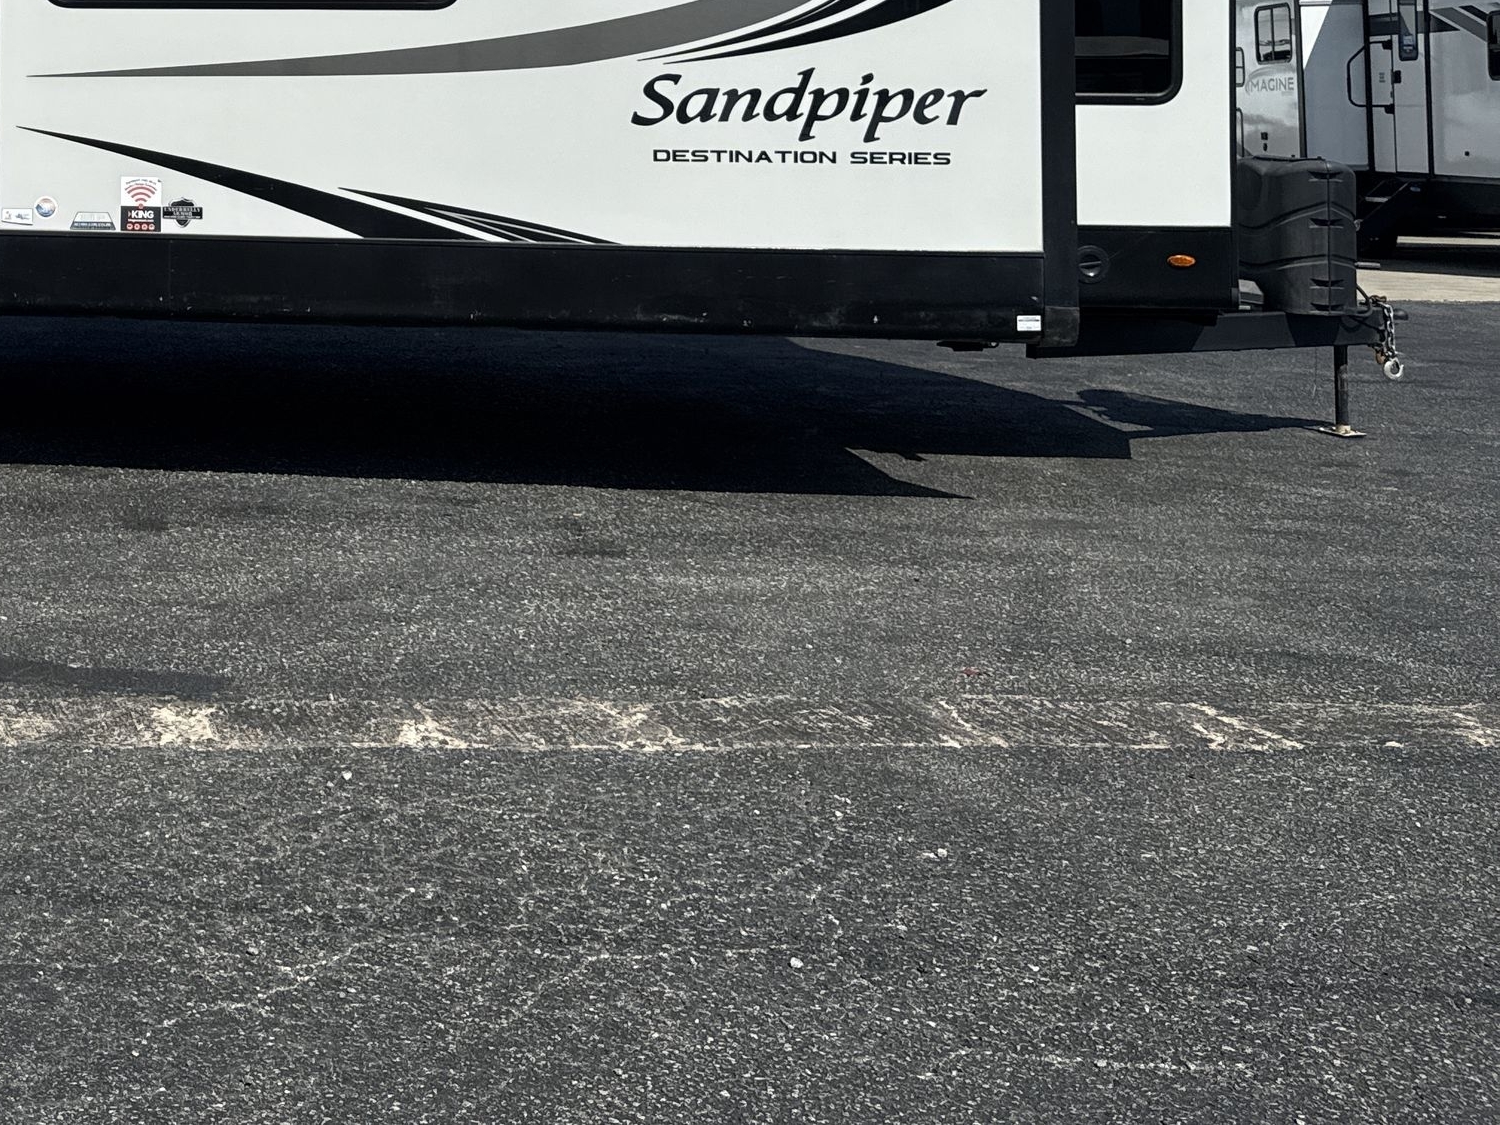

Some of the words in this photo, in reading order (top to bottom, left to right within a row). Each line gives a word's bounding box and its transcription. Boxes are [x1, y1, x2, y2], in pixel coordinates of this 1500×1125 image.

[1247, 77, 1295, 92] IMAGINE
[630, 67, 988, 143] Sandpiper
[652, 149, 837, 164] DESTINATION
[850, 151, 951, 165] SERIES
[131, 210, 154, 219] KING
